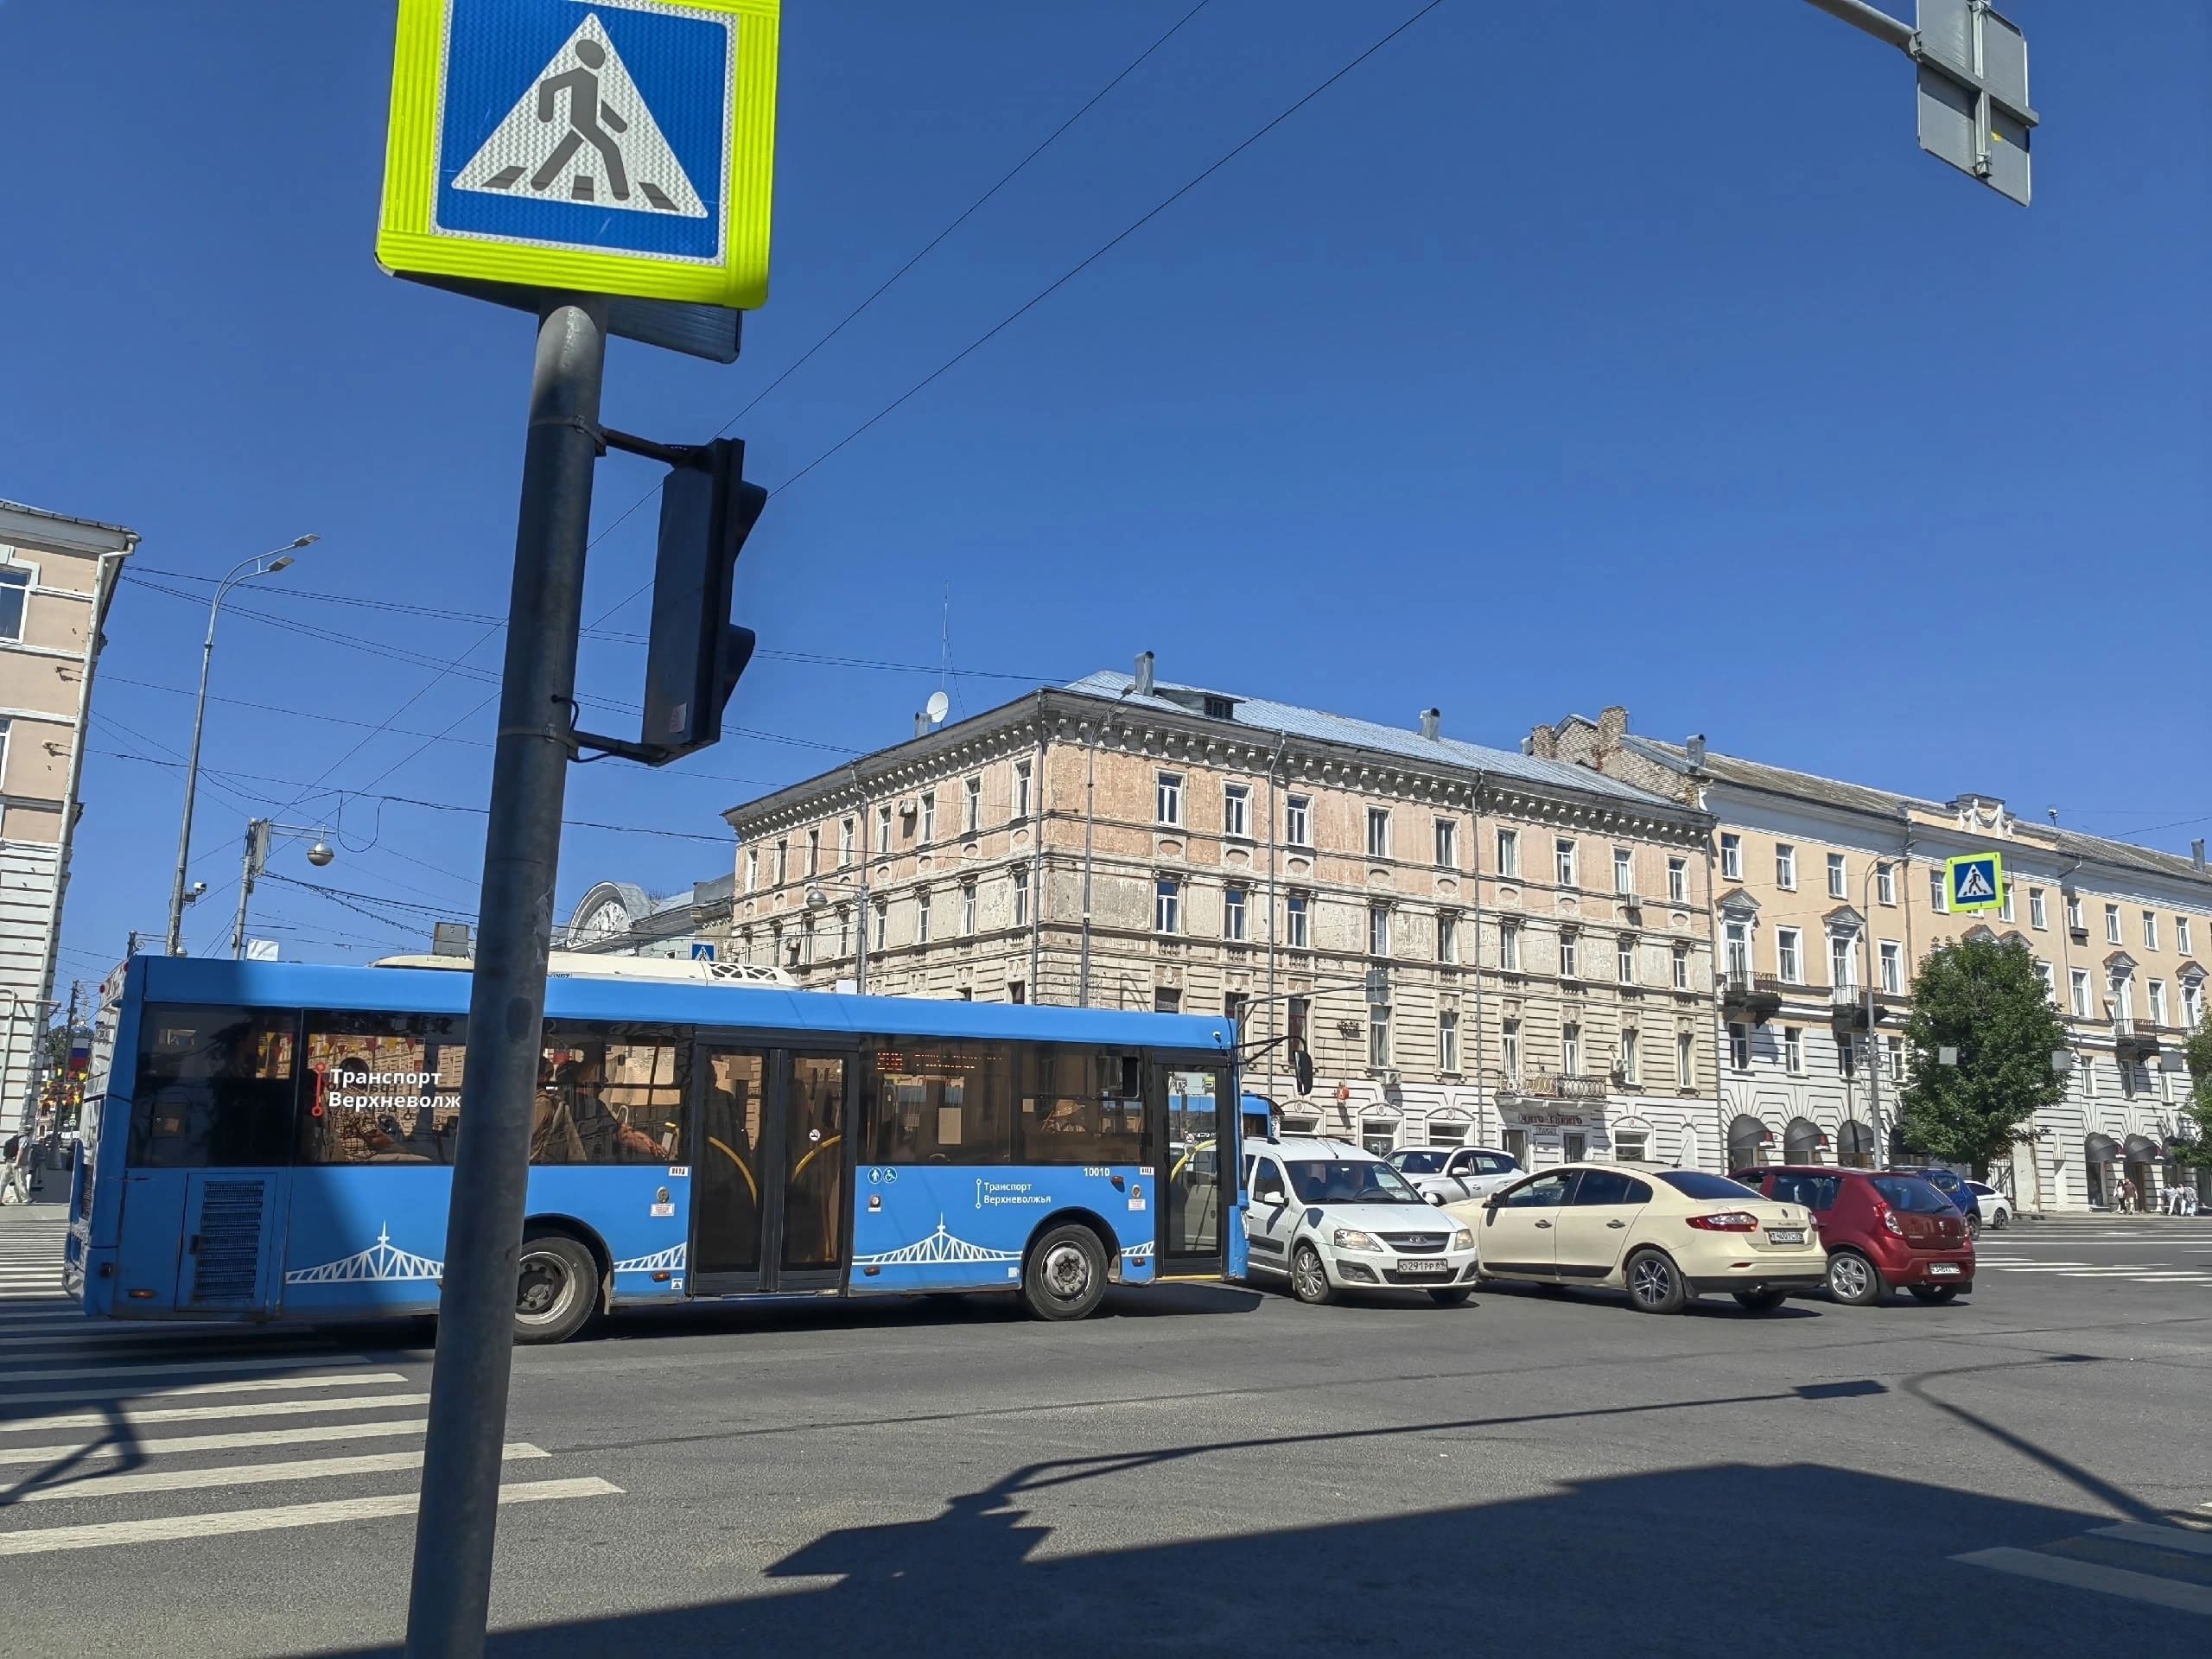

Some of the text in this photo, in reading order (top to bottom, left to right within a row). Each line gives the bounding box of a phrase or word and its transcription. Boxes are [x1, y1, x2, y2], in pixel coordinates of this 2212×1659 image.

[330, 1068, 442, 1088] Транспорт
[328, 1091, 461, 1112] Верхневолж
[1084, 1167, 1110, 1177] 10010
[983, 1182, 1032, 1193] Транспорт
[983, 1195, 1052, 1206] Верхневолжья
